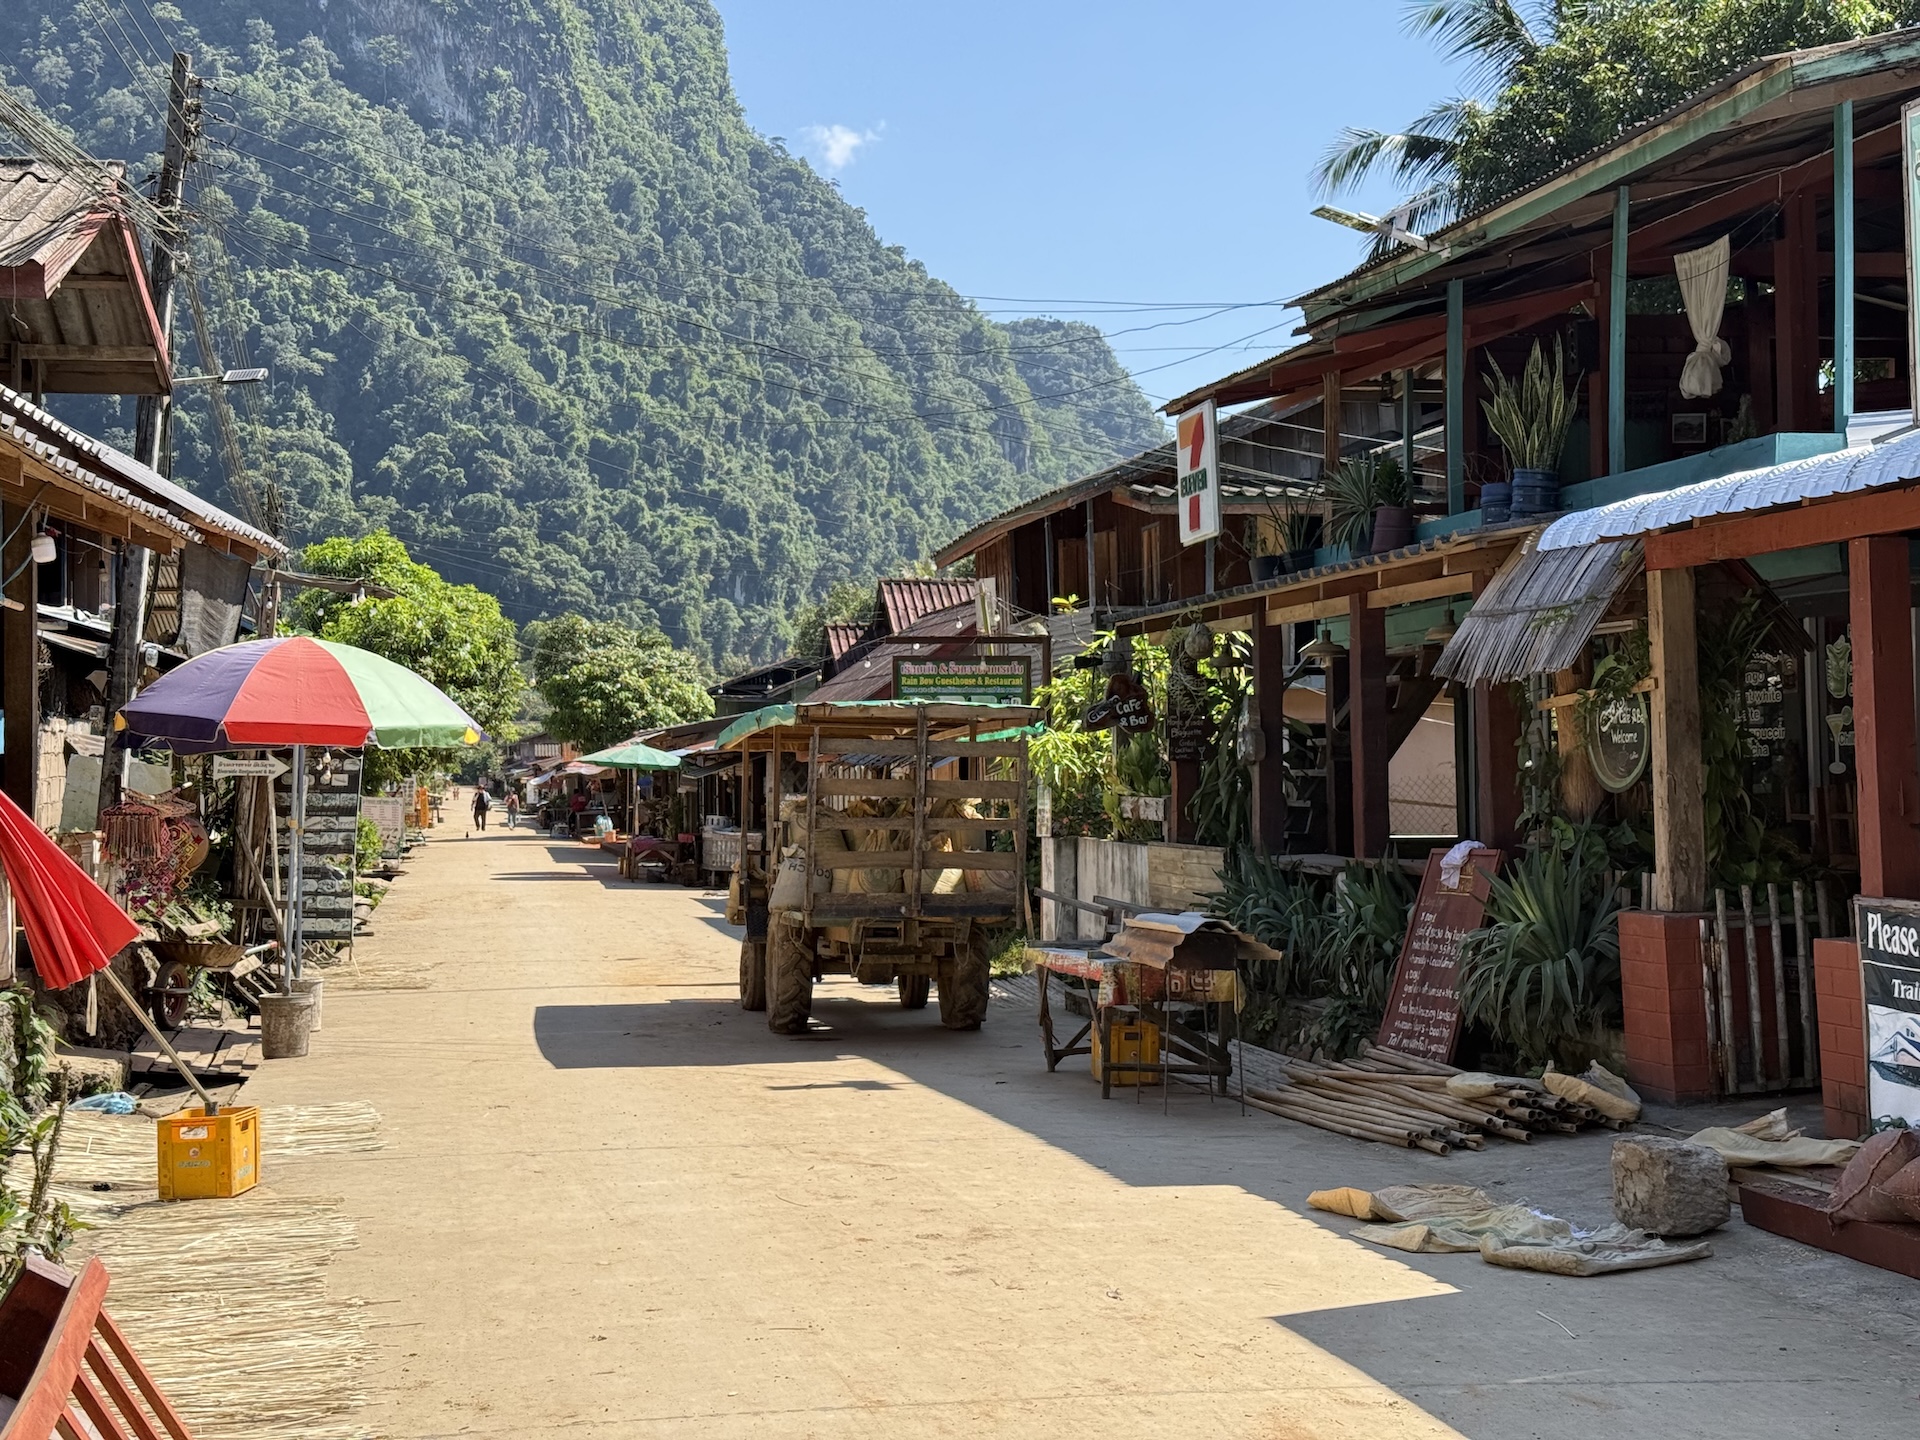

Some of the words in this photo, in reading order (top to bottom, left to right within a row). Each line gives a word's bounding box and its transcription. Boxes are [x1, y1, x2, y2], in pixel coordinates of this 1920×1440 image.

[901, 676, 918, 686] Rain
[919, 677, 934, 686] Bow
[935, 676, 977, 686] Guesthouse
[977, 677, 983, 686] &
[984, 676, 1023, 686] Restaurant
[1753, 689, 1782, 705] white
[1119, 716, 1129, 727] &
[1129, 714, 1149, 727] Bar
[1610, 729, 1638, 744] Welcome
[1867, 911, 1920, 958] Please
